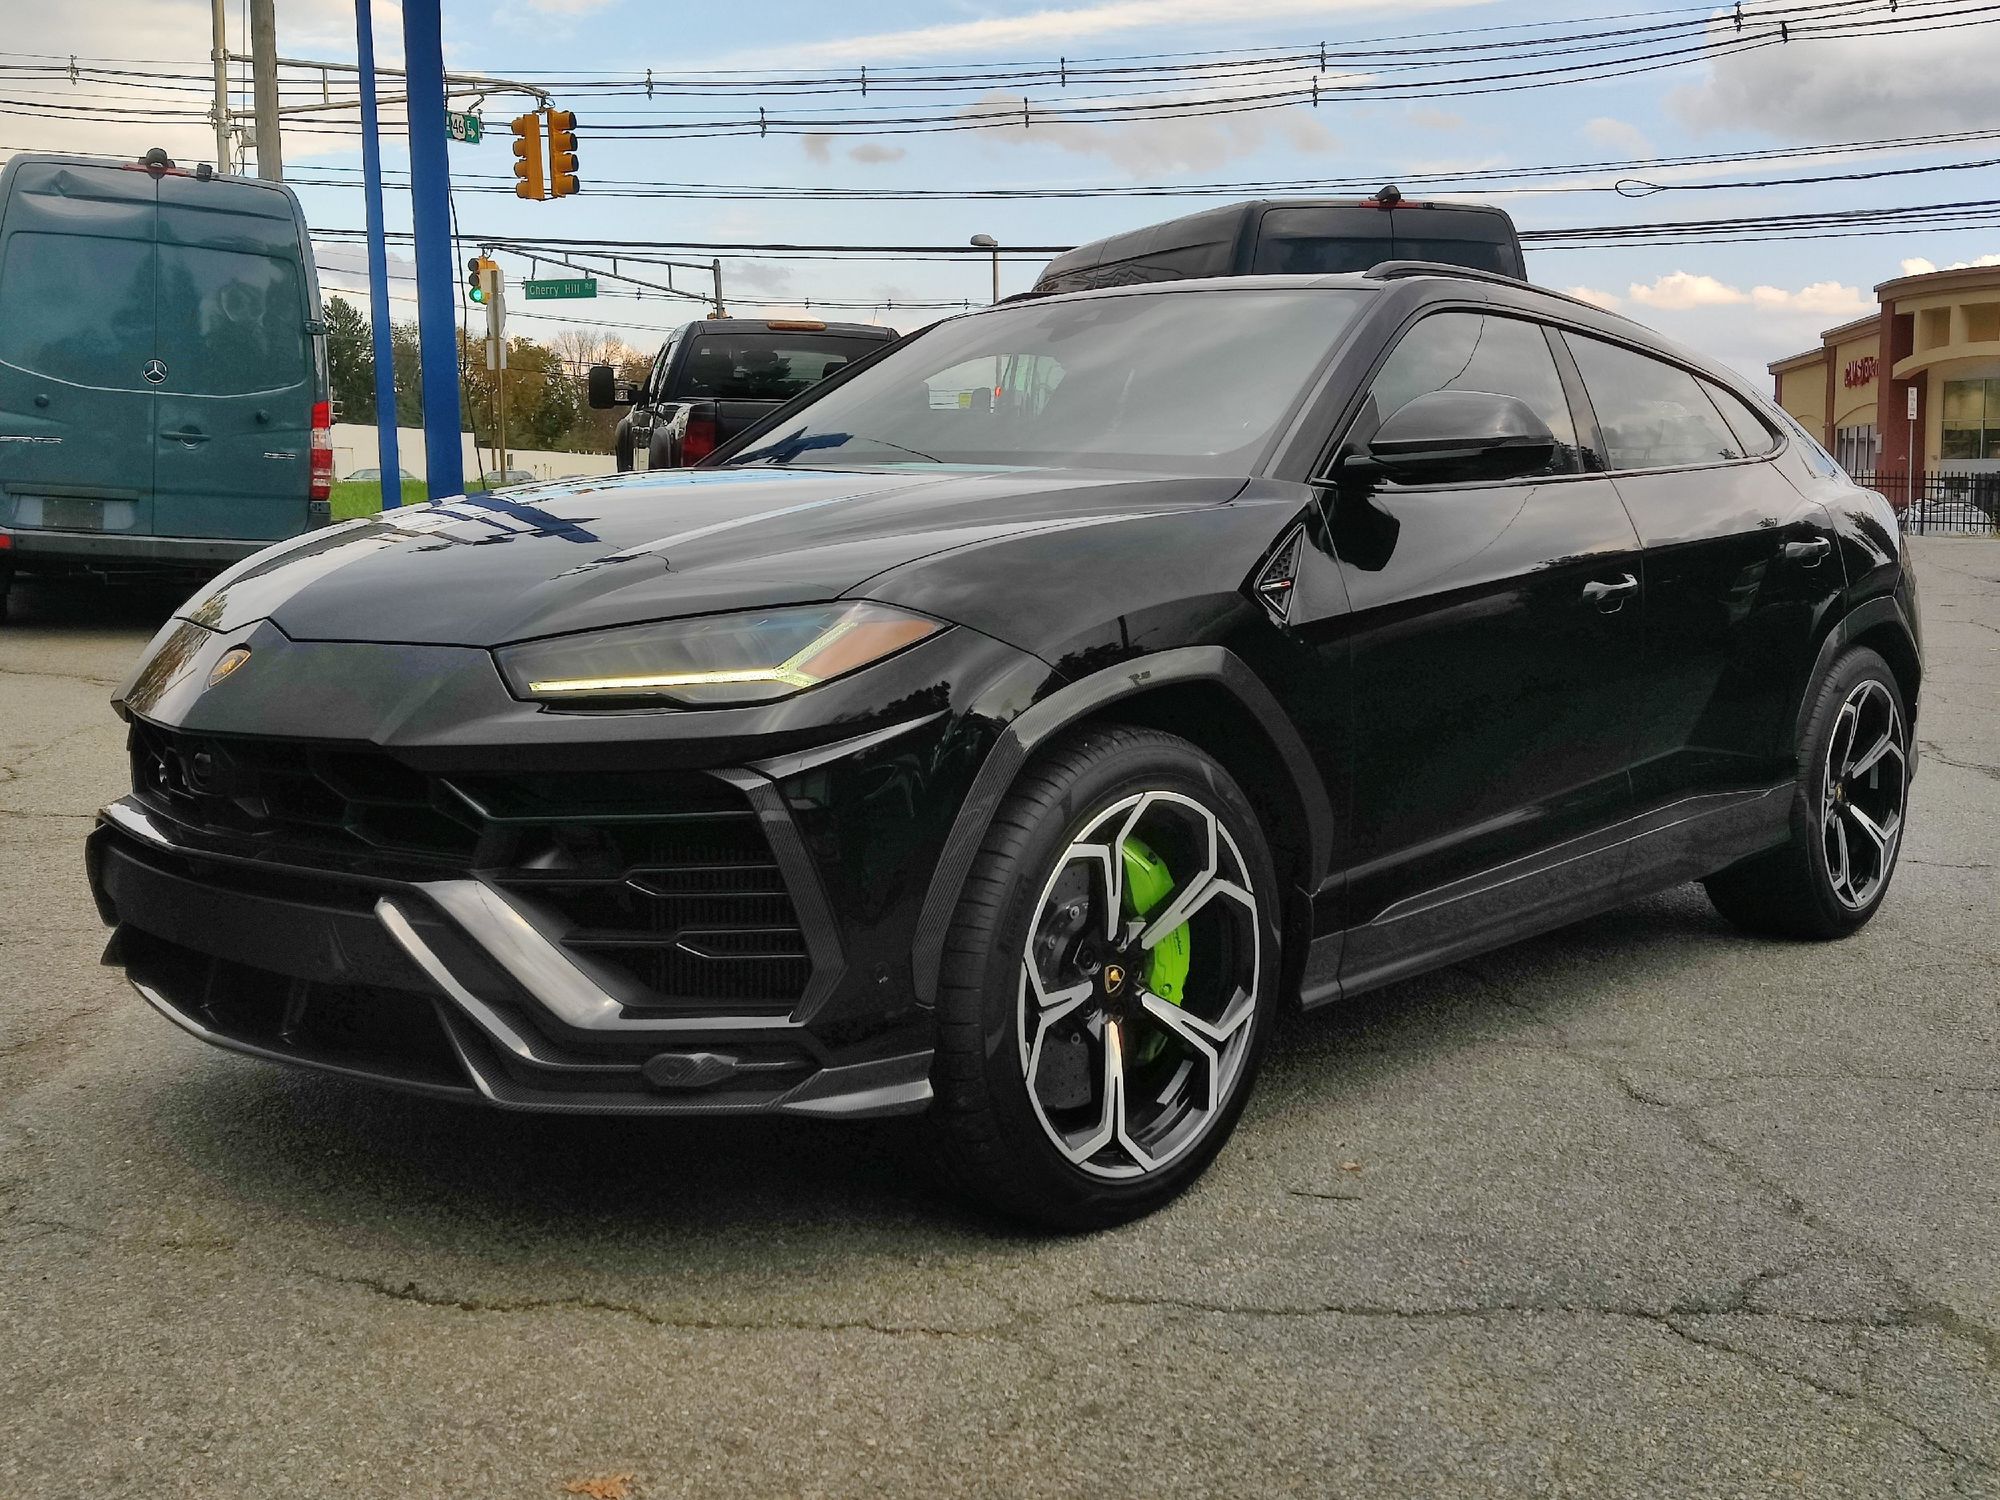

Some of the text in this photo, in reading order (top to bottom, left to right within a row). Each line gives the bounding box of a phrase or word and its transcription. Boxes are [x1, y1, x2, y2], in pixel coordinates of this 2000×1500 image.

[453, 119, 463, 134] 46
[467, 121, 472, 129] E
[529, 285, 559, 296] Cherry
[565, 284, 580, 294] Hill
